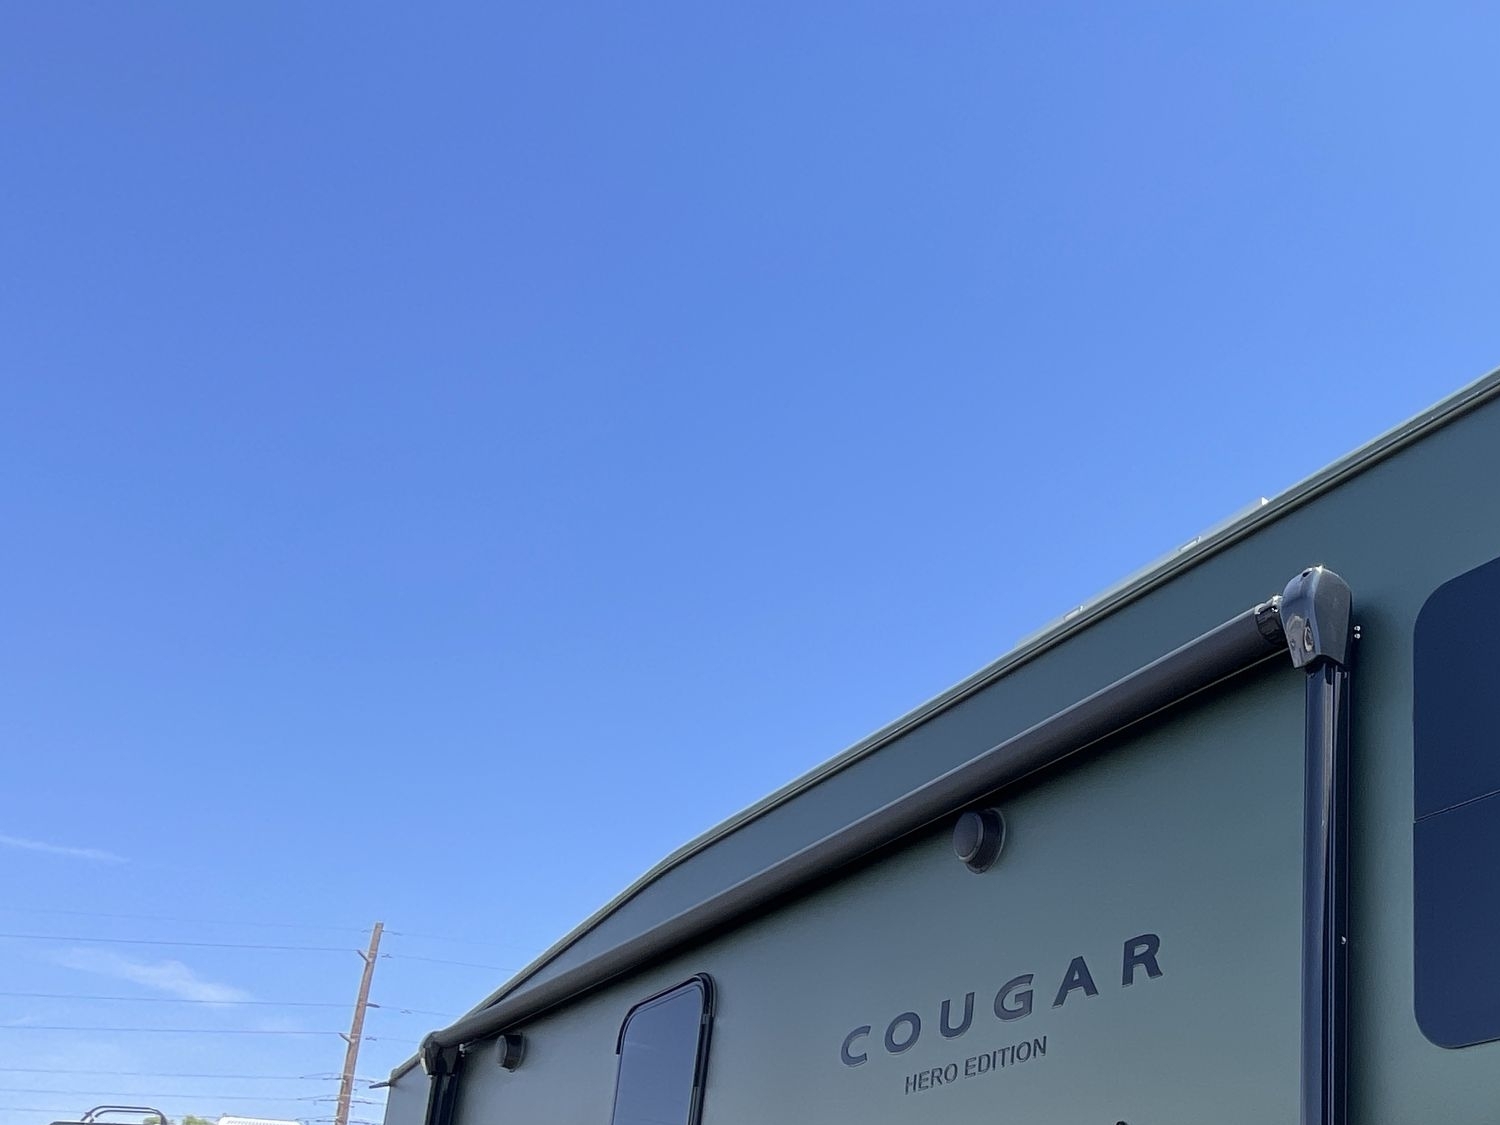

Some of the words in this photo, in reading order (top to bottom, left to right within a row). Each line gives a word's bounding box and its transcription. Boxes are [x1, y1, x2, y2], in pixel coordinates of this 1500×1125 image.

[840, 933, 1163, 1067] COUGAR
[904, 1062, 958, 1095] HERO
[964, 1035, 1048, 1079] EDITION
